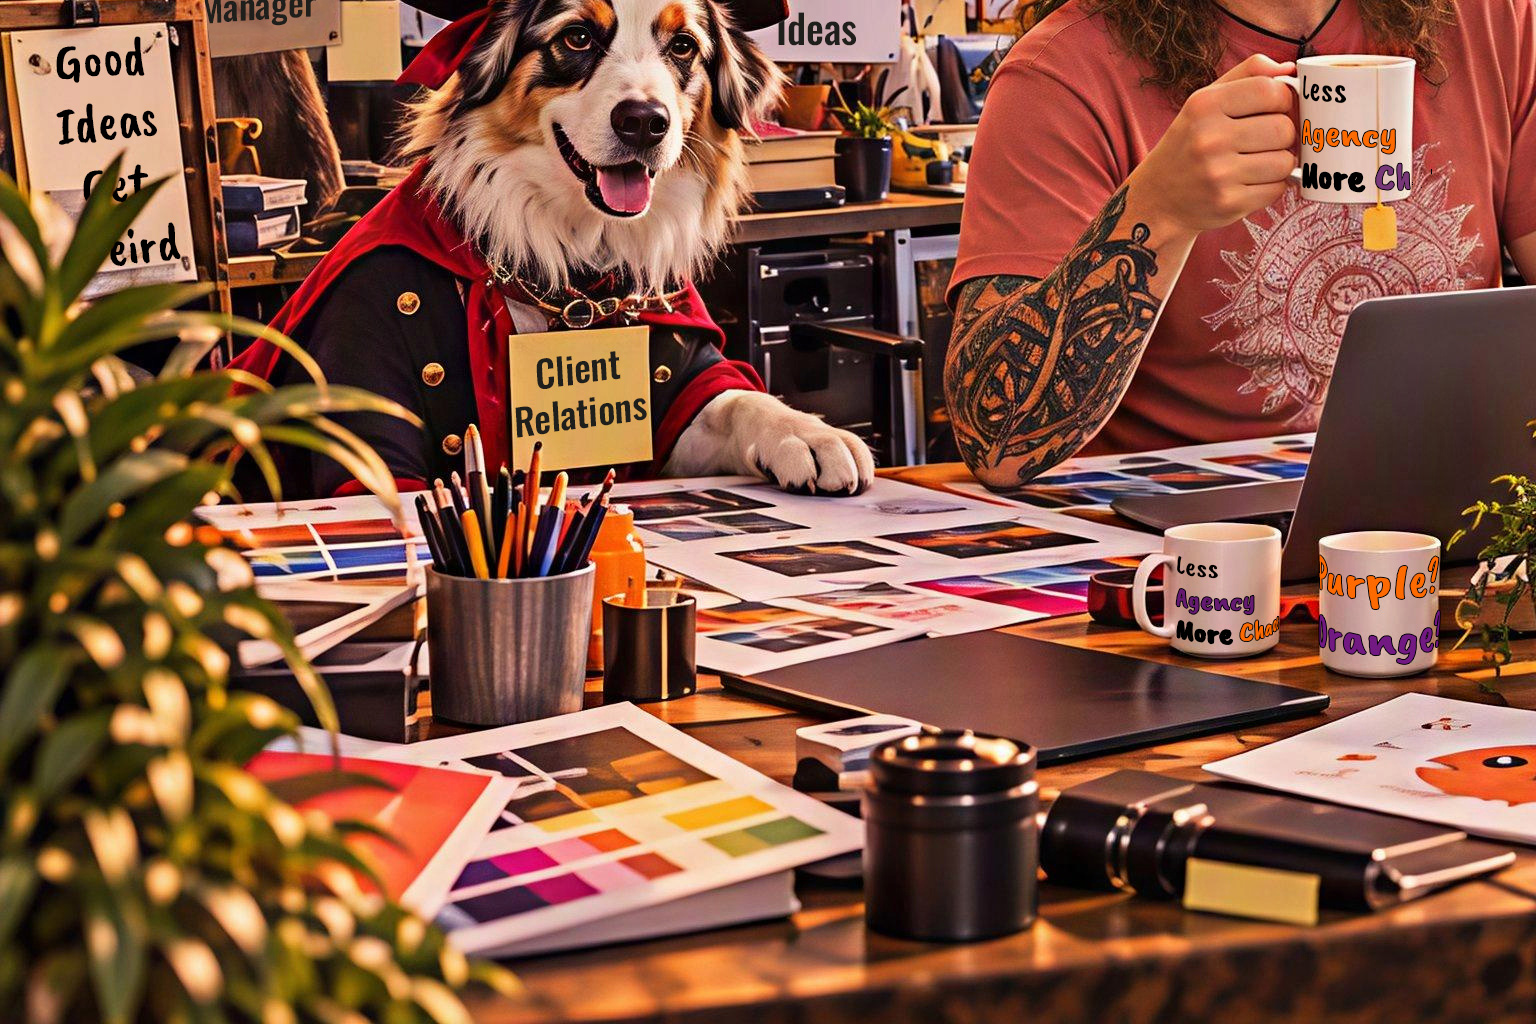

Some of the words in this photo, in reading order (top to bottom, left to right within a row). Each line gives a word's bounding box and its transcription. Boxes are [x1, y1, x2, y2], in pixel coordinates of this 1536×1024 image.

[777, 12, 856, 46] Ideas
[56, 36, 145, 83] Good
[1303, 75, 1346, 103] Less
[56, 104, 157, 145] Ideas
[1302, 119, 1396, 154] Agency
[1302, 162, 1366, 192] More
[110, 222, 180, 266] eird
[536, 351, 620, 389] Client
[515, 397, 647, 438] Relations
[1176, 556, 1218, 578] Less
[1320, 555, 1439, 610] Purple?
[1176, 588, 1255, 615] Agency
[1176, 620, 1233, 645] More
[1319, 610, 1440, 665] Orange?
